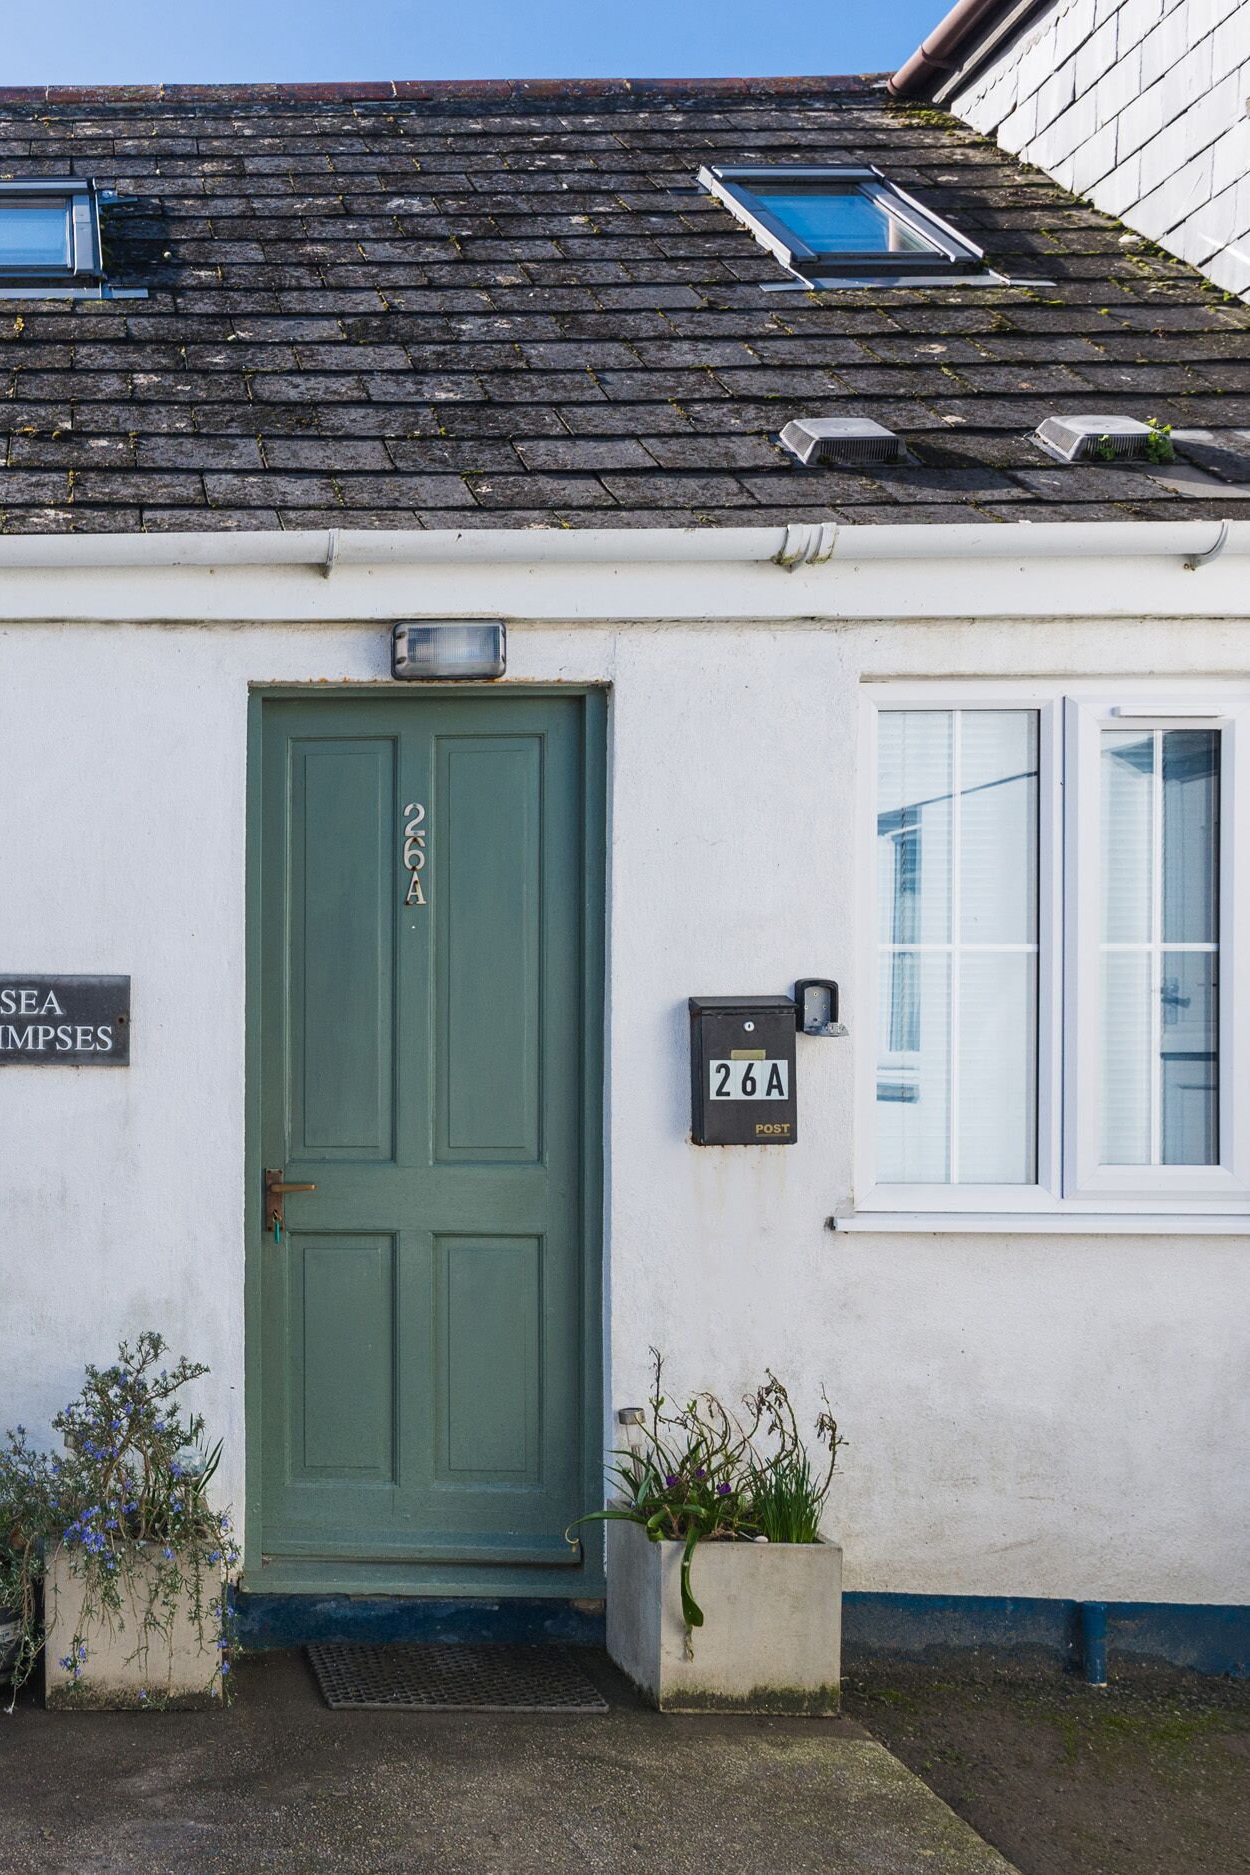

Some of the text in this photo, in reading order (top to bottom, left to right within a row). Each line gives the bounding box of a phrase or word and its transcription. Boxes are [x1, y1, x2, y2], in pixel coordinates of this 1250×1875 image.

[403, 802, 427, 905] 26A
[0, 988, 64, 1016] SEA
[715, 1062, 785, 1097] 26A
[755, 1123, 791, 1134] POST
